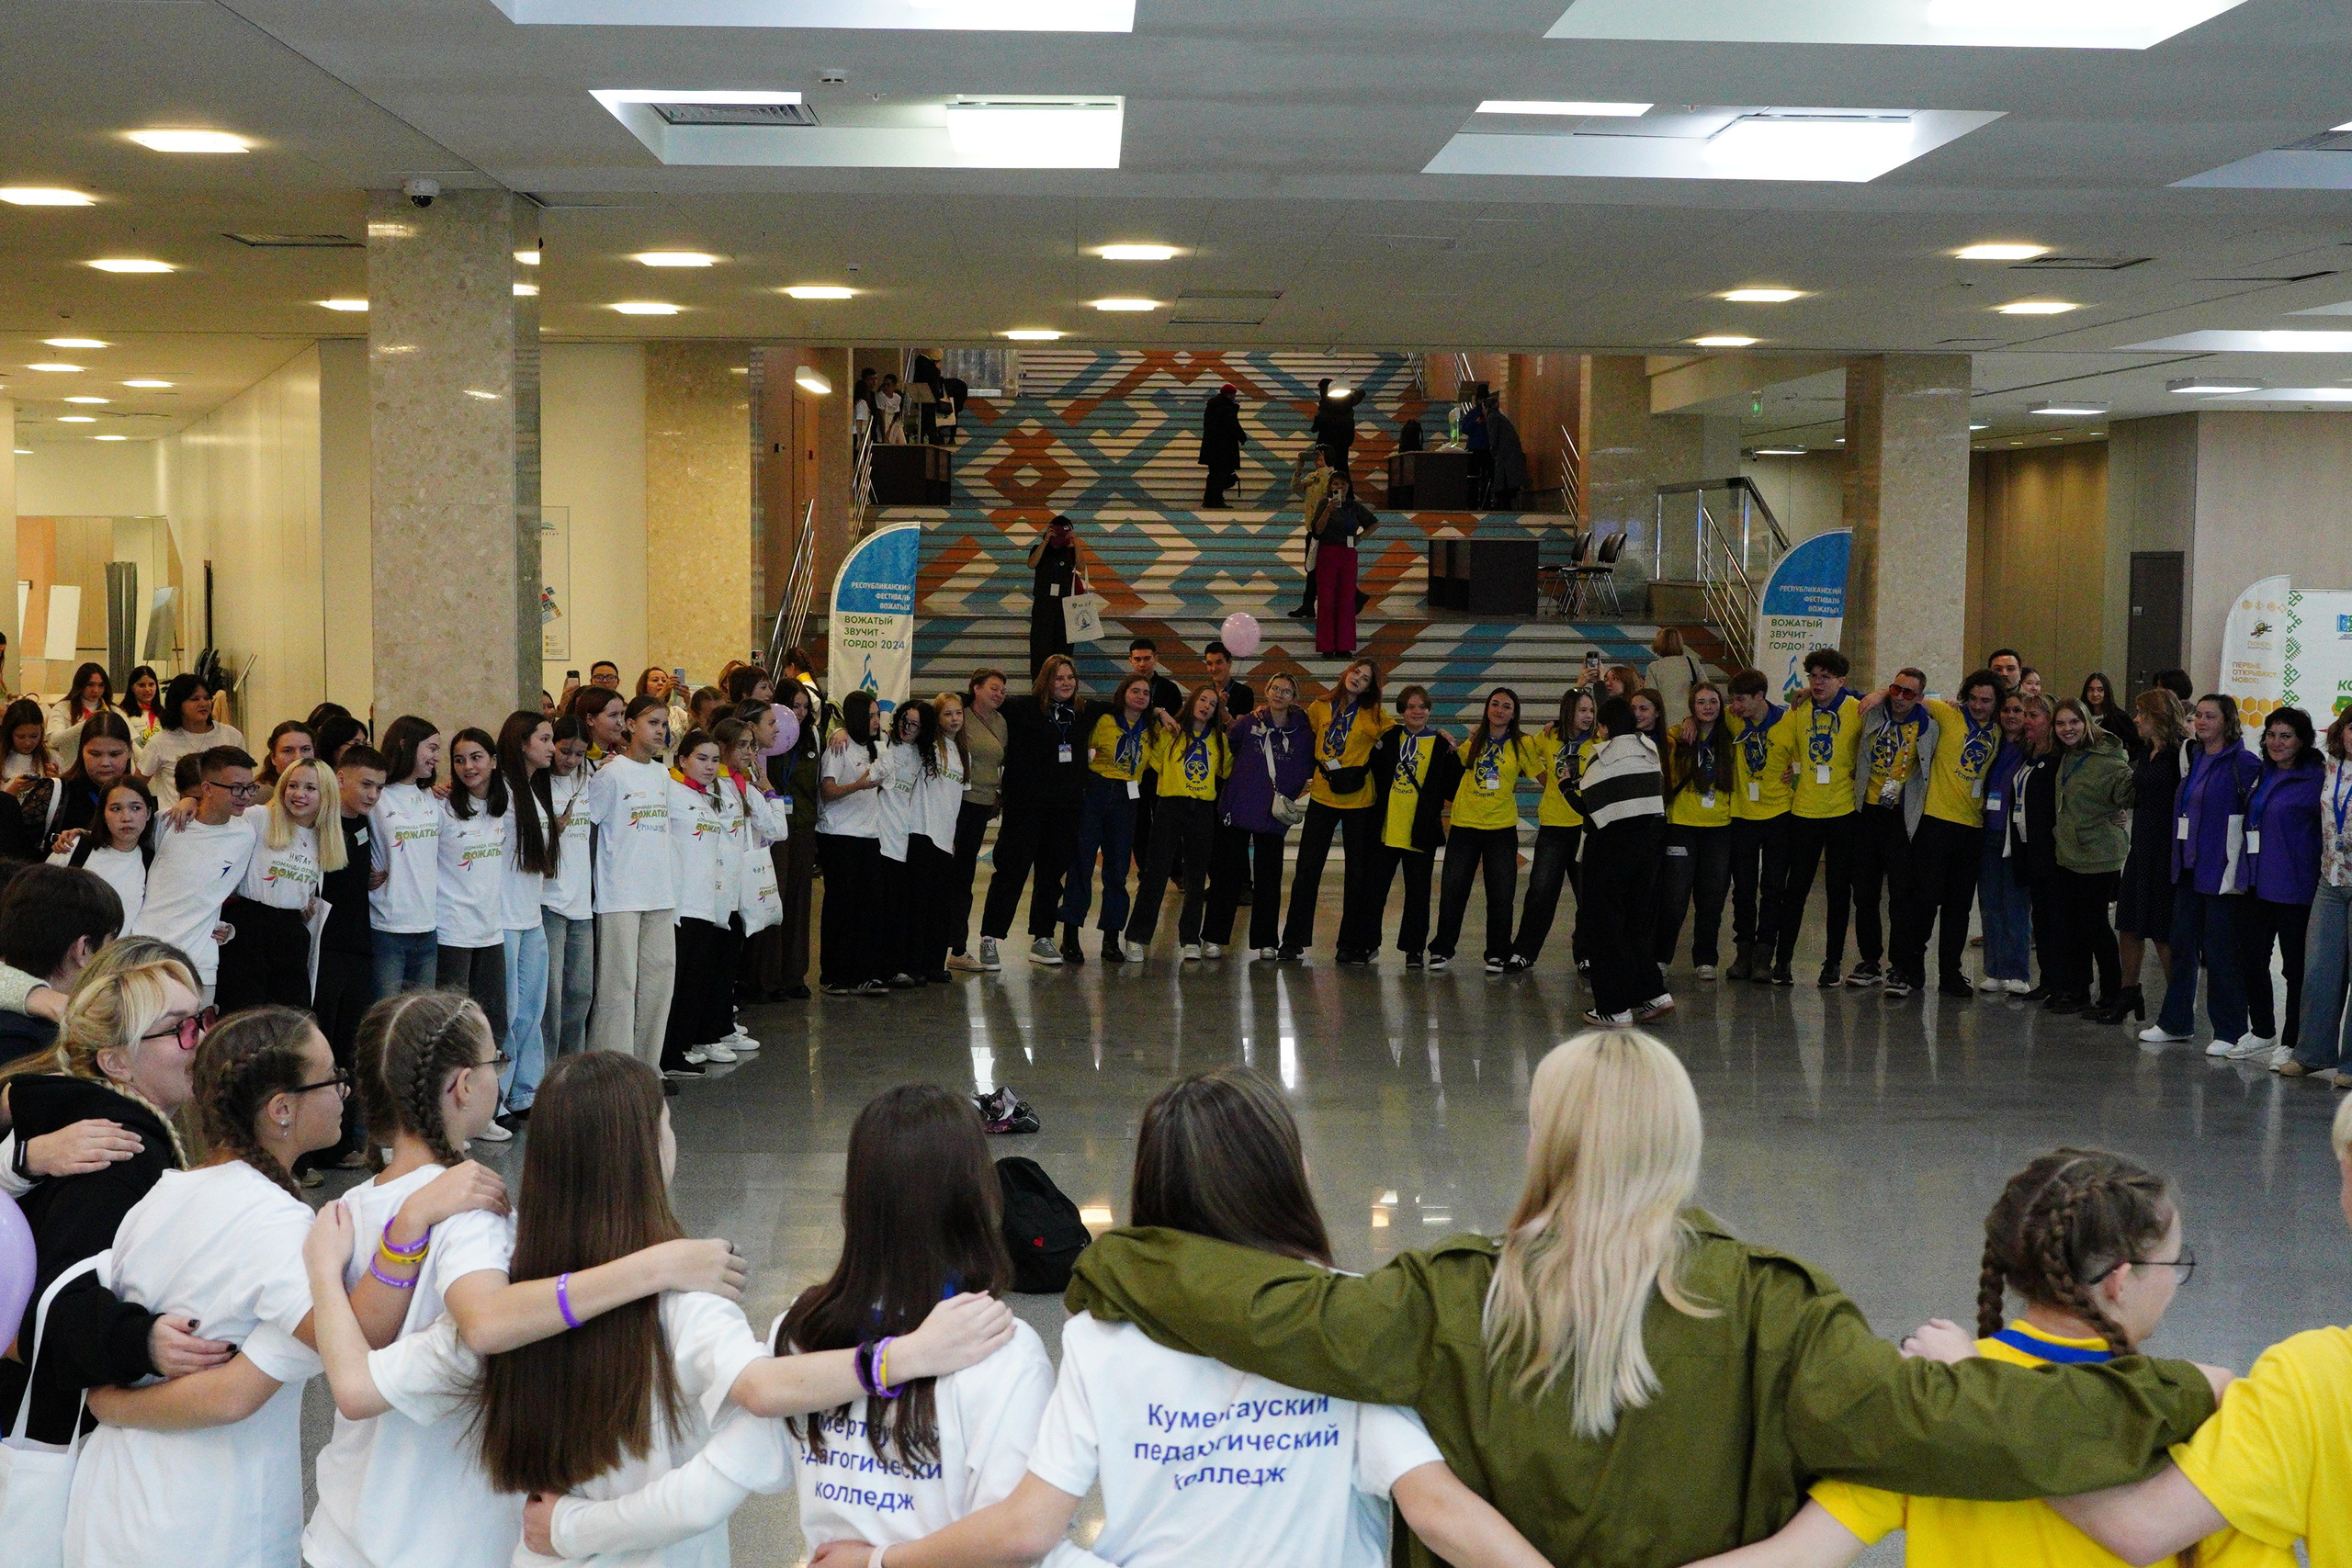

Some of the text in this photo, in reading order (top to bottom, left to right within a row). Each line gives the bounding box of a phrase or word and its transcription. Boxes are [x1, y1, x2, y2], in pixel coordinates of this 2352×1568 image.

[851, 581, 911, 591] РЕСПУБЛИКАНСКИЙ
[1779, 585, 1842, 595] РЕСПУБЛИКАНСКИЙ
[875, 592, 911, 602] ФЕСТИВАЛЬ
[1803, 595, 1840, 604] ФЕСТИВАЛЬ
[879, 603, 910, 611] ВОЖАТЫХ
[844, 615, 893, 626] ВОЖАТЫЙ
[1770, 618, 1823, 627] ВОЖАТЫЙ
[843, 626, 879, 637] ЗВУЧИТ
[1770, 630, 1807, 639] ЗВУЧИТ
[842, 638, 905, 649] ГОРДО! 2024
[1769, 641, 1804, 651] ГОРДО!
[1185, 783, 1208, 792] Успеха
[815, 1481, 915, 1513] колледж
